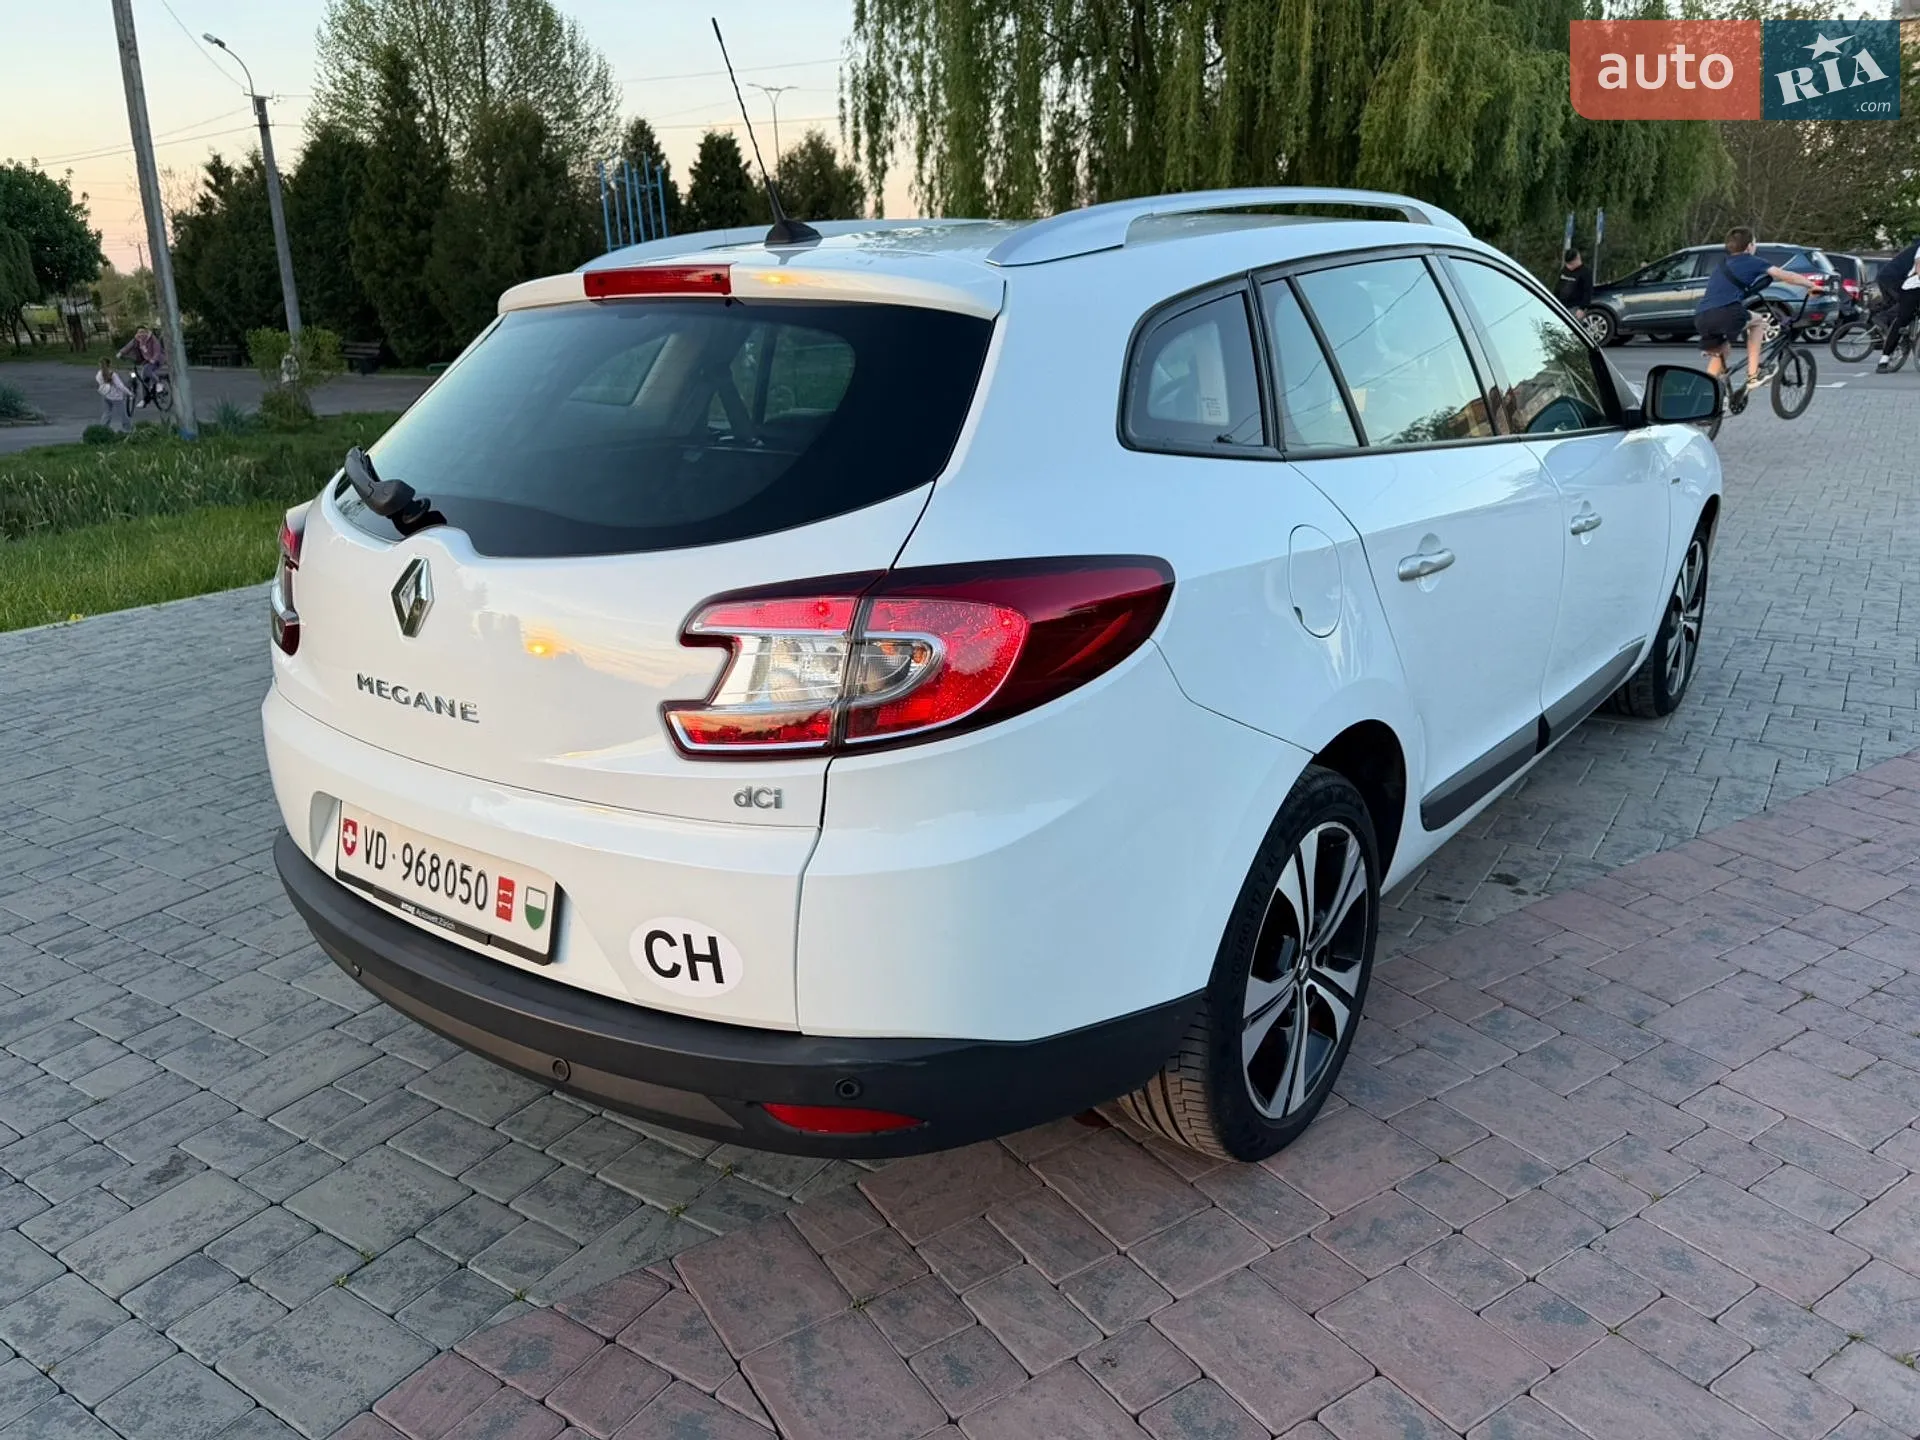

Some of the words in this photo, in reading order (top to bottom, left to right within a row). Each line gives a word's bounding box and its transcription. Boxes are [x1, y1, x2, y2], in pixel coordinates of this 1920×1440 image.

[356, 672, 480, 724] MEGANE
[733, 786, 783, 809] dCi
[644, 929, 725, 984] CH
